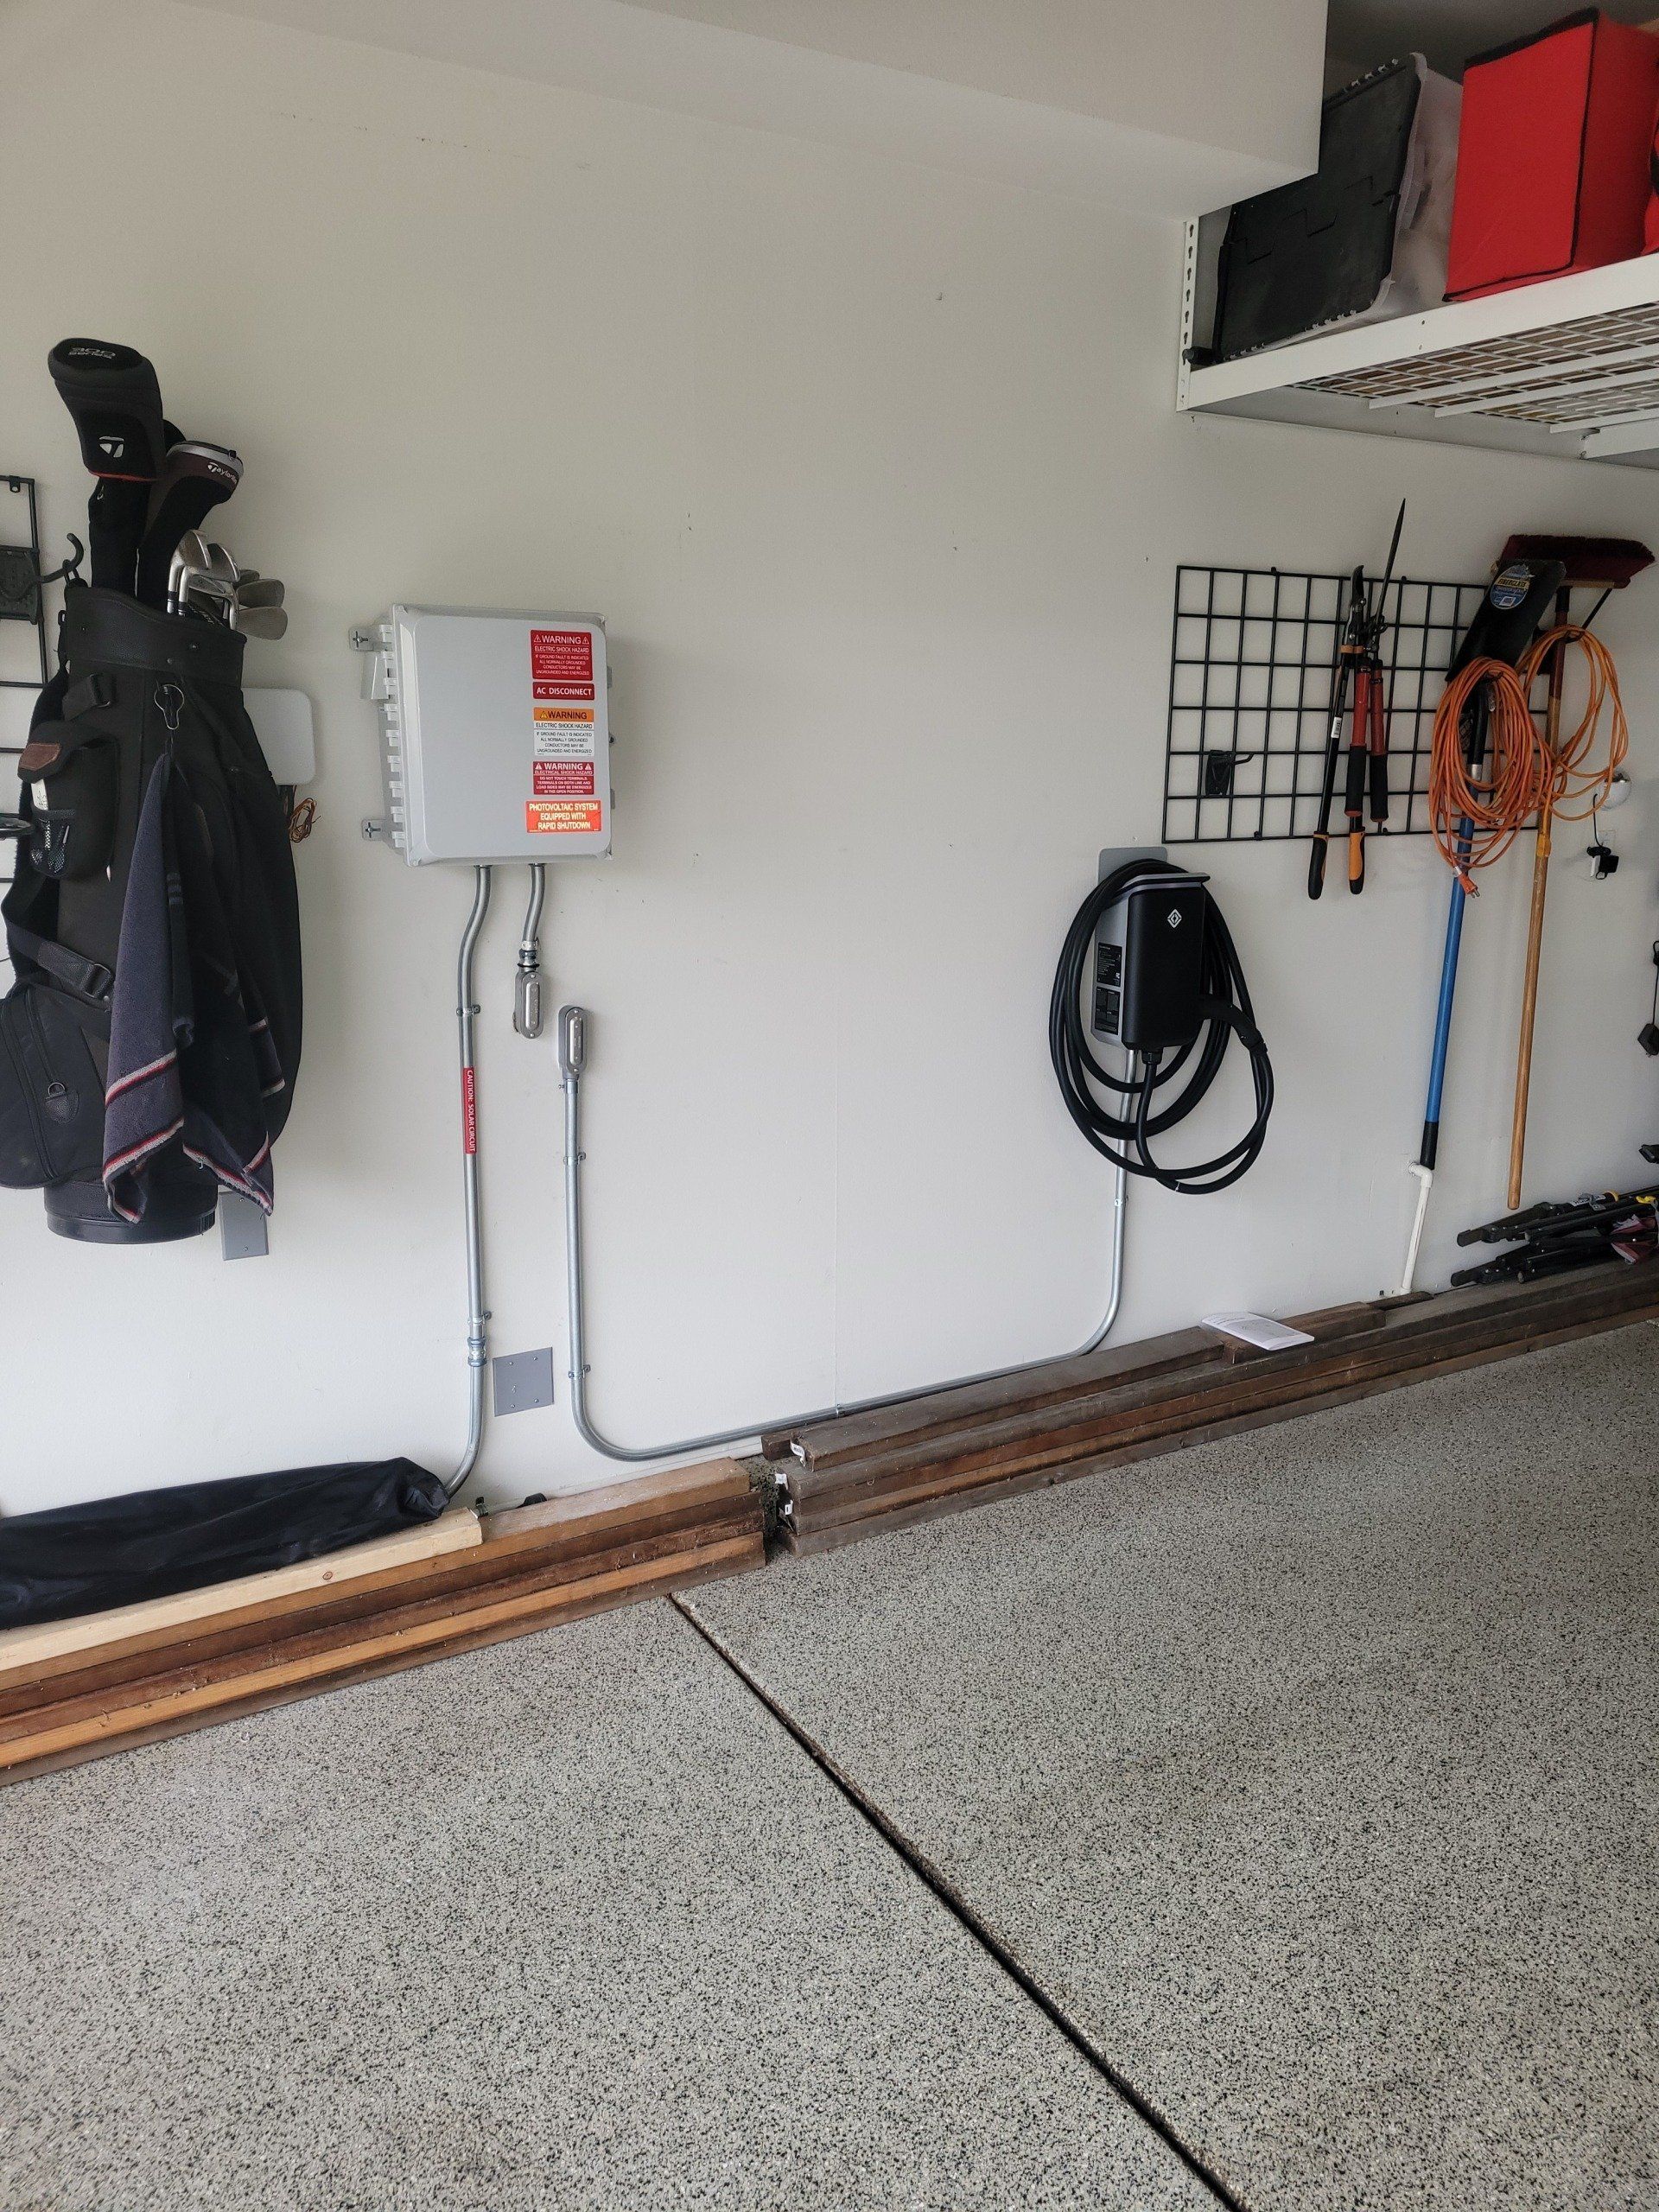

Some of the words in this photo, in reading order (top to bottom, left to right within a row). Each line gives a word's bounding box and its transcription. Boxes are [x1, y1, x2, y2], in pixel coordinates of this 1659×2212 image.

[208, 462, 238, 484] TaylorM
[542, 635, 581, 644] WARNING
[548, 711, 587, 719] WARNING
